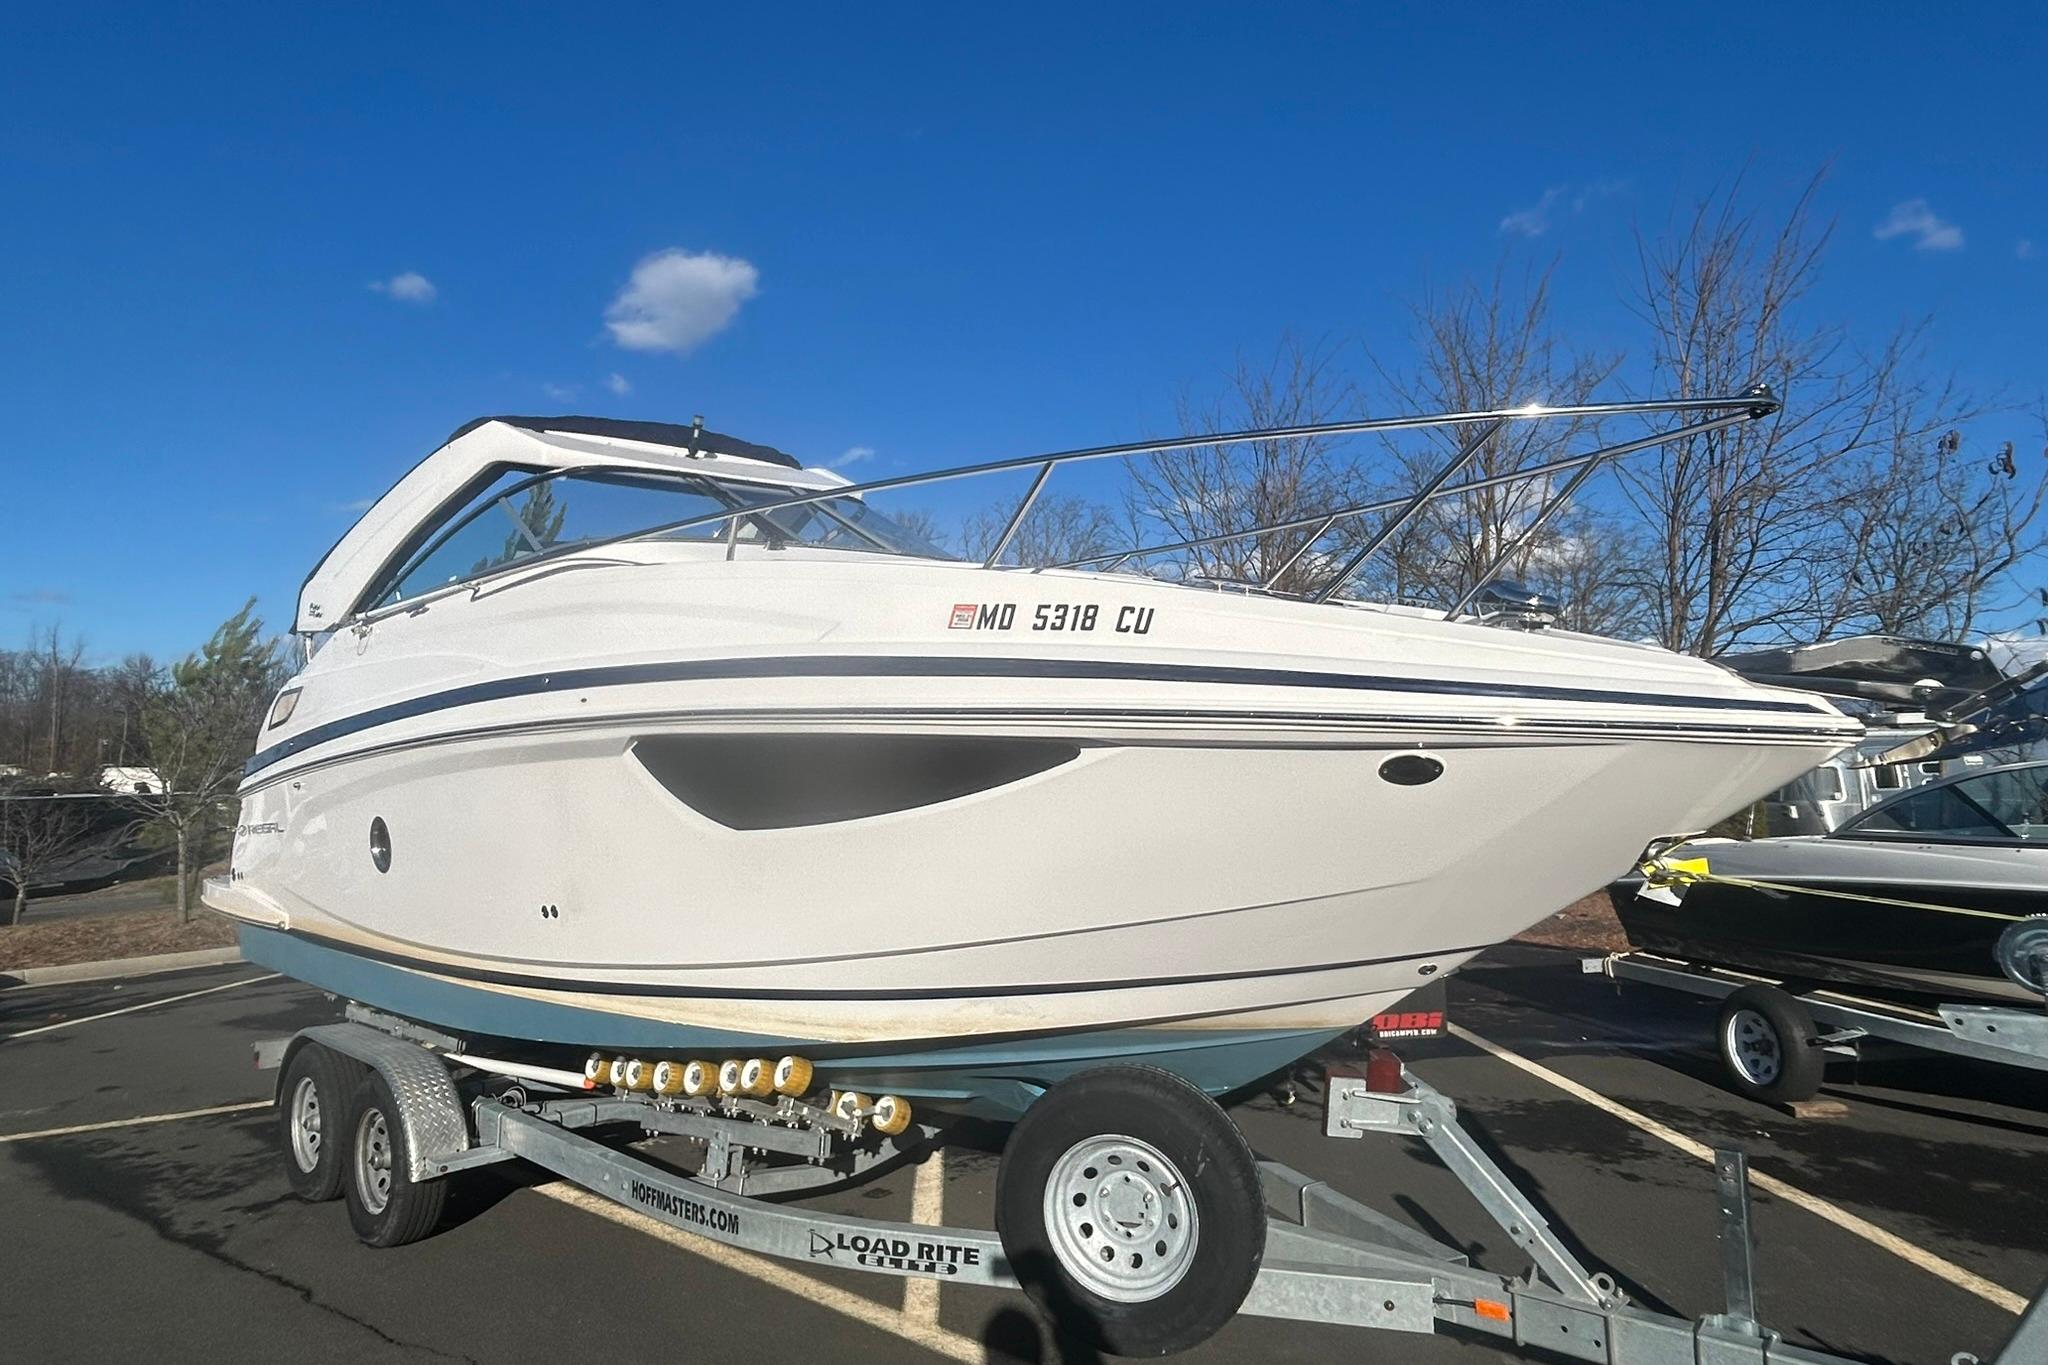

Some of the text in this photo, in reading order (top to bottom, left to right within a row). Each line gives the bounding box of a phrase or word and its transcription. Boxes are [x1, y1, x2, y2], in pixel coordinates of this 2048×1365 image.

[976, 603, 1017, 631] MD
[1032, 604, 1099, 632] 5318
[1115, 605, 1155, 635] CU
[631, 1179, 740, 1236] HOFFMASTERS.COM
[837, 1232, 981, 1267] LOAD RITE
[863, 1254, 951, 1274] ELITE
